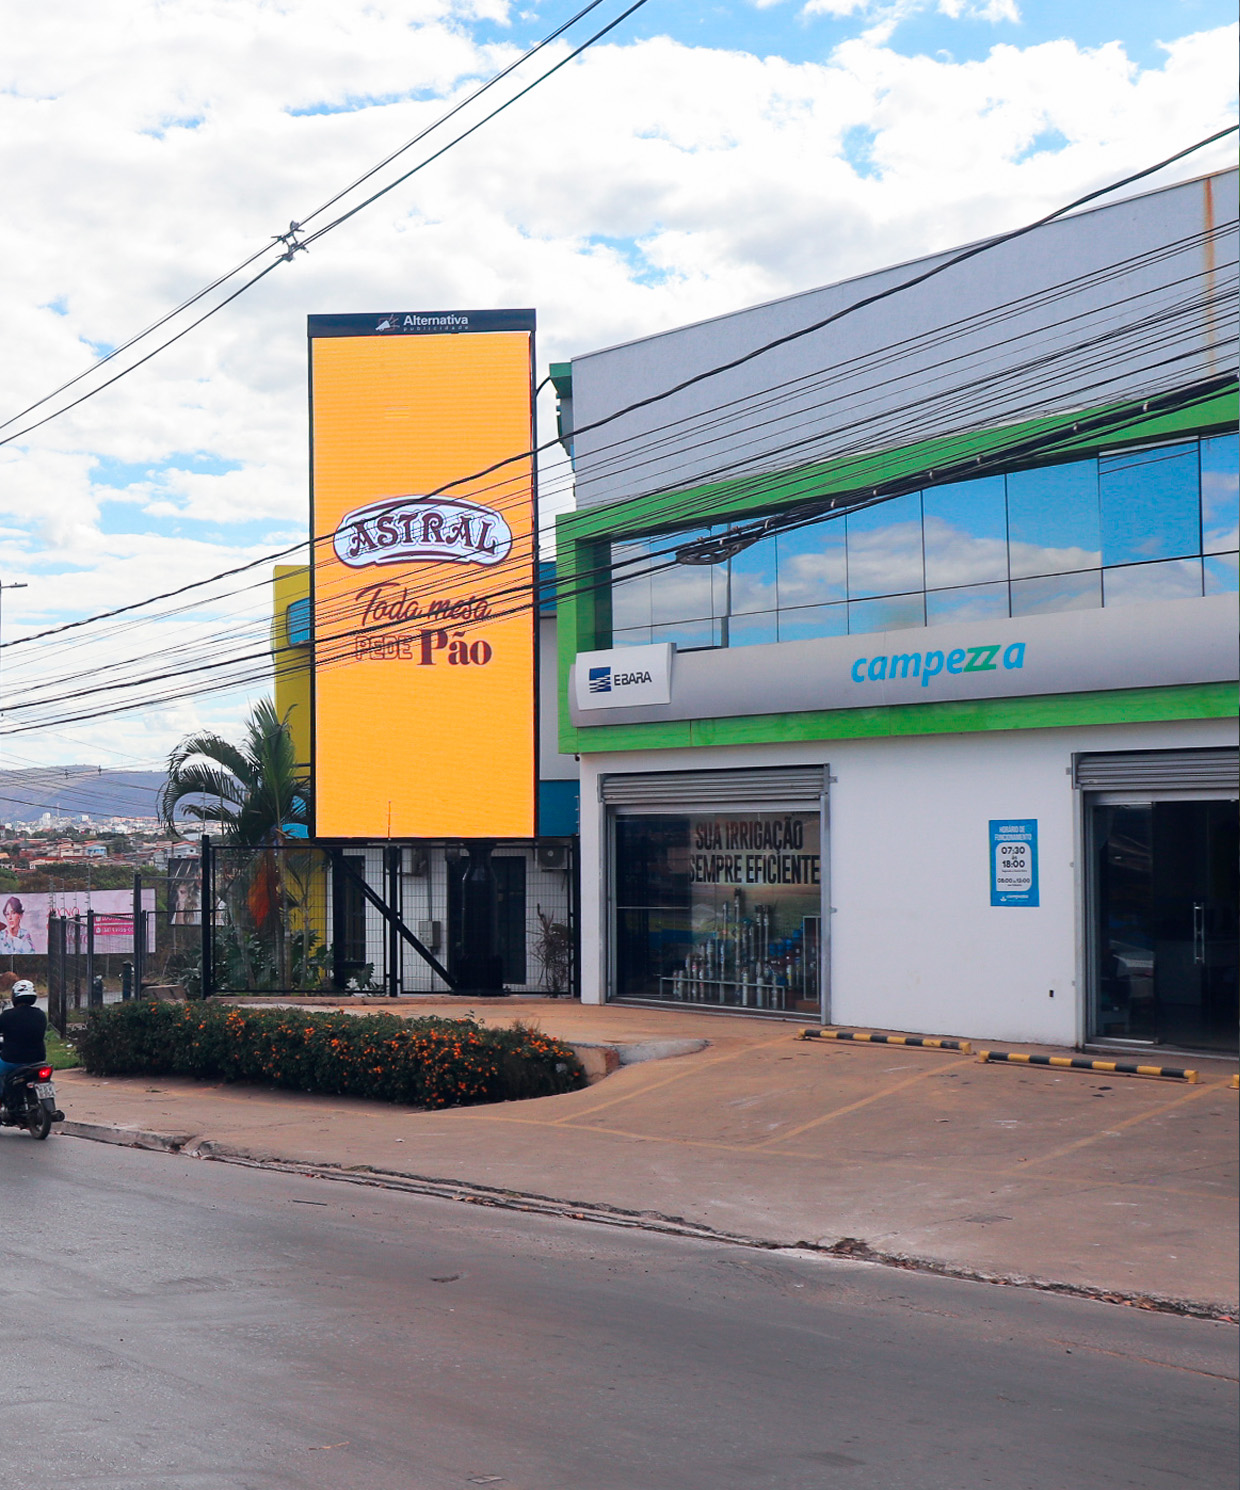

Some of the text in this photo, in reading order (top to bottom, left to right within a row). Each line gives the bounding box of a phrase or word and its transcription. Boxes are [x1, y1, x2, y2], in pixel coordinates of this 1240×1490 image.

[403, 313, 469, 326] Alternativa
[349, 511, 498, 557] ASTRAL
[355, 582, 493, 627] Toda mesa
[355, 628, 493, 666] PEDE Pão
[613, 671, 653, 686] EBARA
[850, 642, 1027, 688] campezza
[695, 816, 804, 854] SUA IRRIGAÇÃO
[1001, 846, 1026, 855] 07:30
[689, 853, 821, 885] SEMPRE EFICIENTE
[1002, 859, 1026, 868] 18:00
